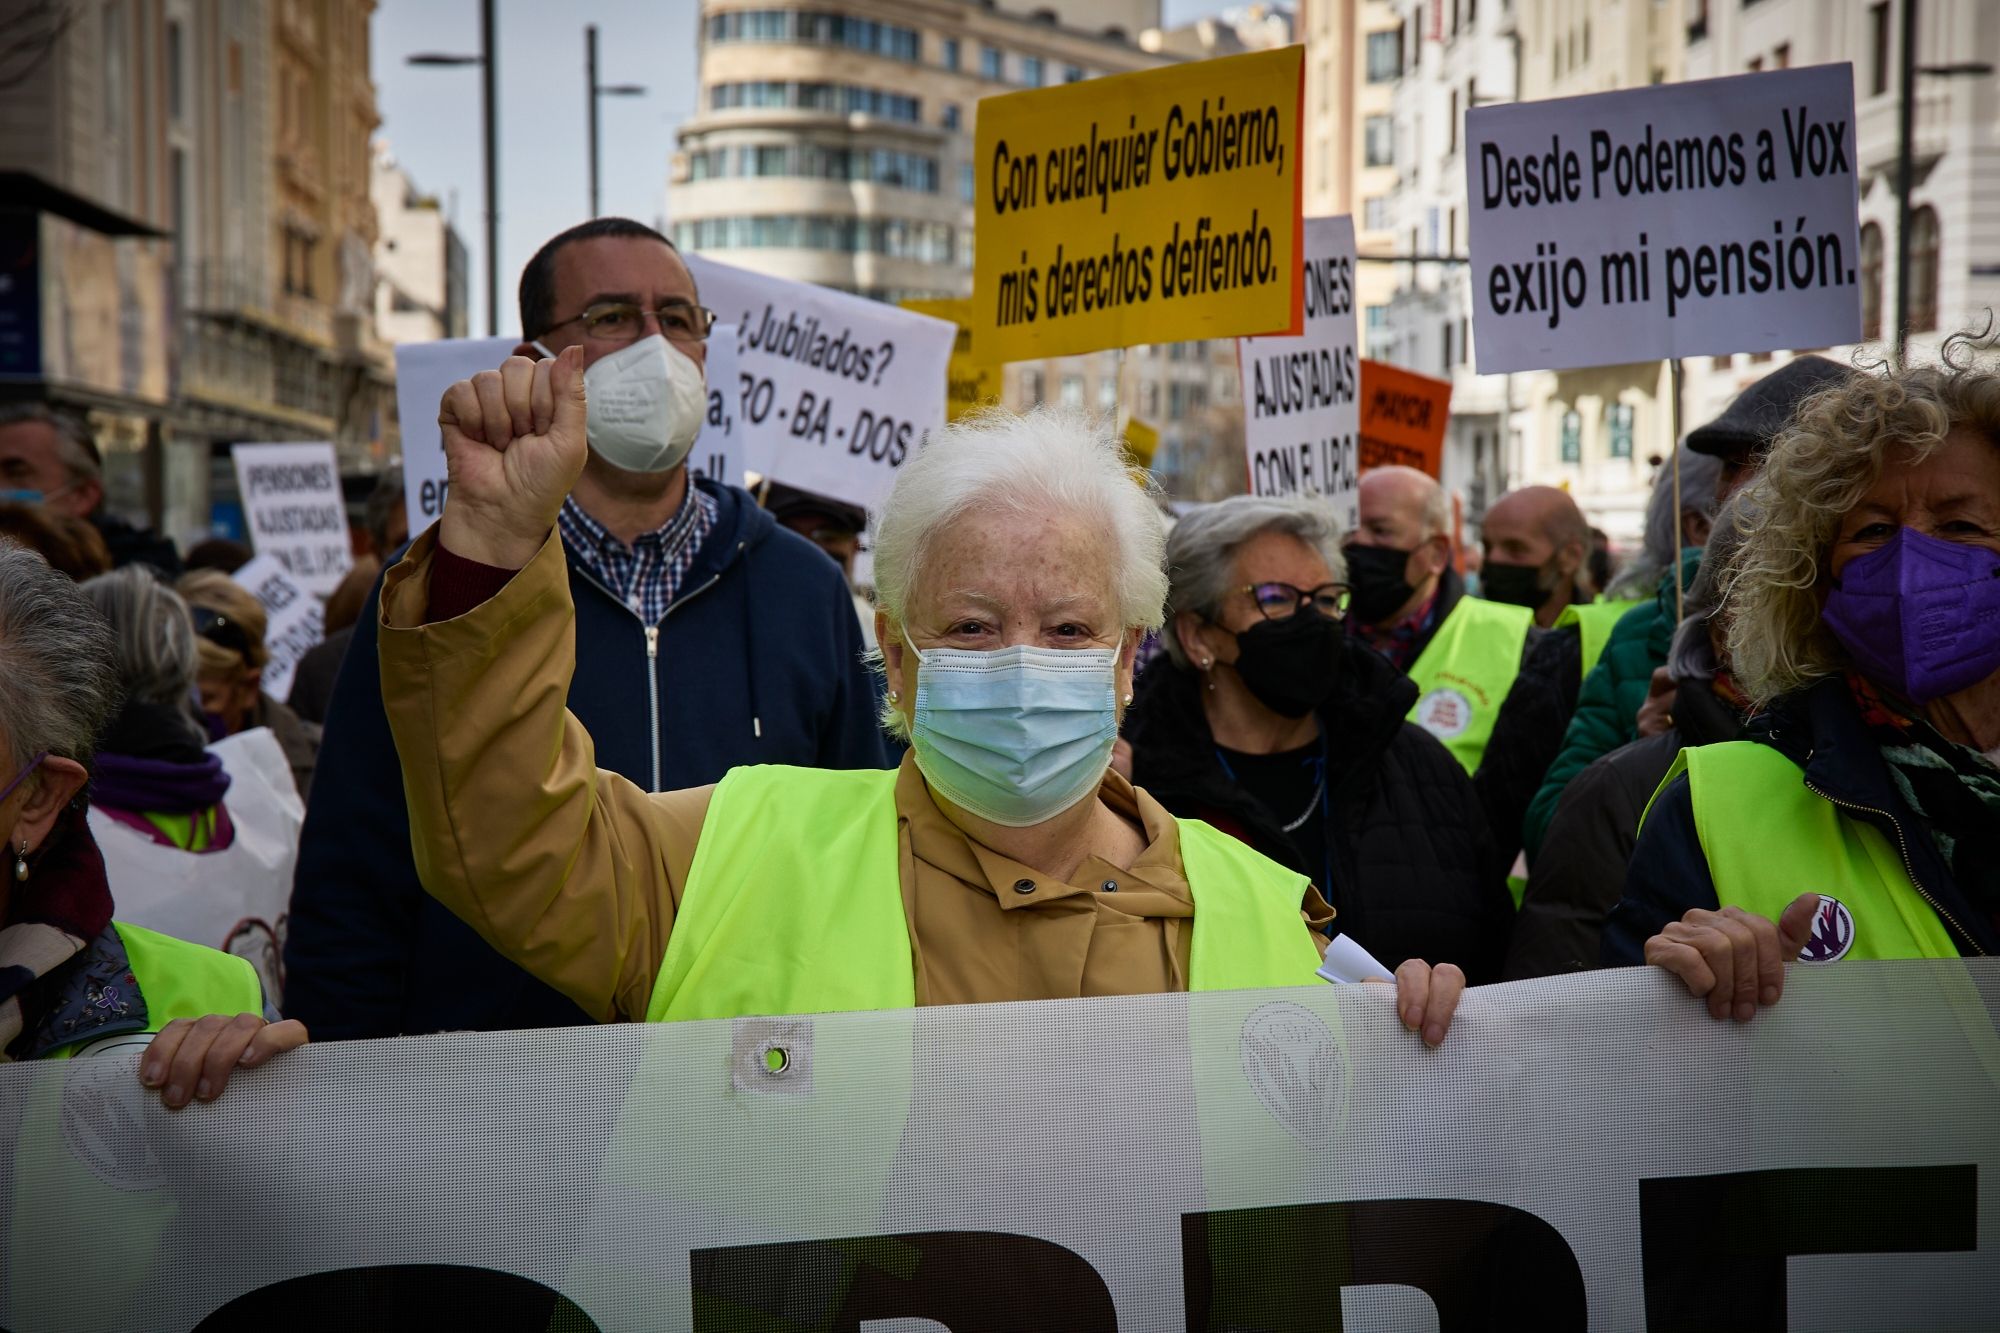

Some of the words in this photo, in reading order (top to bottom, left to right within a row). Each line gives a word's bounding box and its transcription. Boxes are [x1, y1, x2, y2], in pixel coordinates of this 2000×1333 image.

[991, 138, 1038, 214] Con
[1044, 114, 1158, 213] cualquier
[1163, 96, 1285, 181] Gobierno,
[1481, 135, 1581, 210] Desde
[1591, 124, 1746, 199] Podemos
[1756, 129, 1776, 182] a
[1781, 106, 1849, 178] Vox
[996, 250, 1038, 327] mis
[1046, 233, 1154, 318] derechos
[1161, 209, 1278, 299] defiendo.
[1488, 242, 1587, 329] exijo
[1601, 233, 1650, 305] mi
[1666, 217, 1857, 318] pensión.
[791, 390, 831, 446] BA
[848, 408, 914, 469] DOS
[1254, 345, 1354, 418] AJUSTADAS
[1255, 446, 1297, 497] CON
